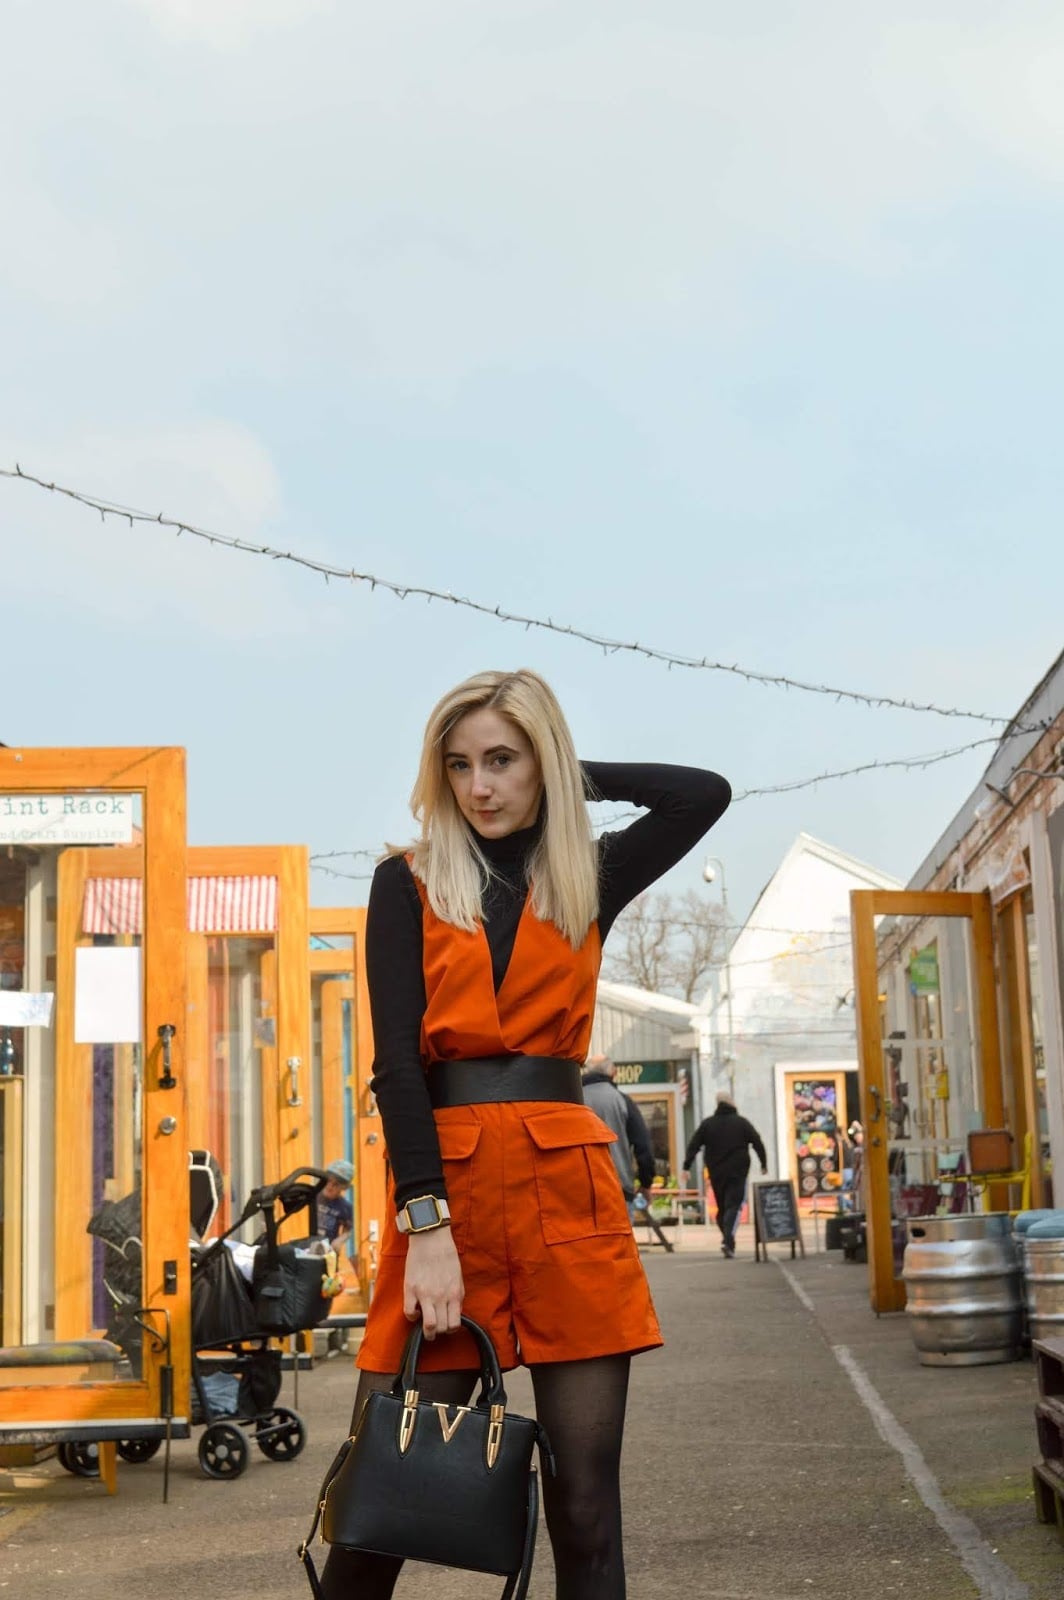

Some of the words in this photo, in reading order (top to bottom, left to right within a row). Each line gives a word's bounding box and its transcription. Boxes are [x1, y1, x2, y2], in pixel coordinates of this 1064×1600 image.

[63, 795, 125, 815] Rack
[64, 828, 126, 842] Supplies
[613, 1064, 644, 1083] HOP
[432, 1402, 472, 1443] V
